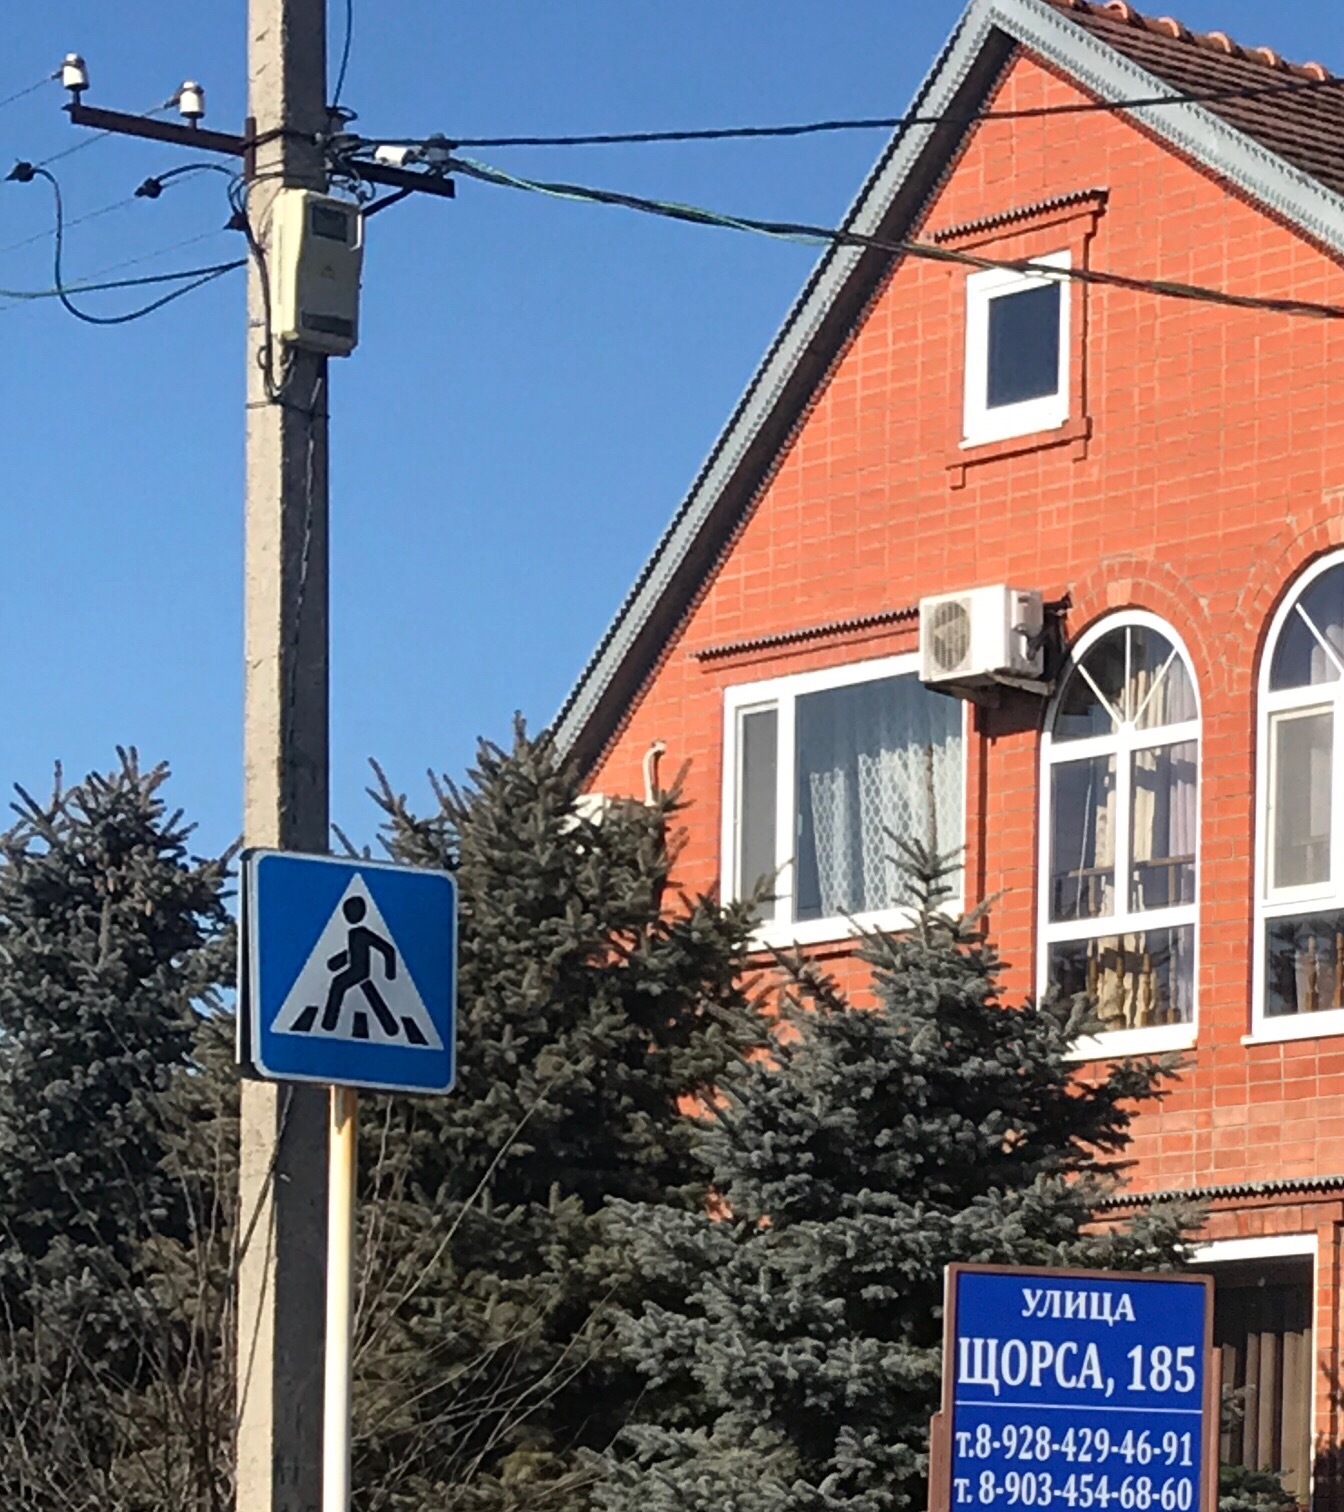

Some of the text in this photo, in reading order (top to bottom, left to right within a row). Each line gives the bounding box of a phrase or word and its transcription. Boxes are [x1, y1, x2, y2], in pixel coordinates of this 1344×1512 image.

[1022, 1289, 1136, 1326] УЛИЦА
[958, 1337, 1195, 1397] ЩОРСА, 185
